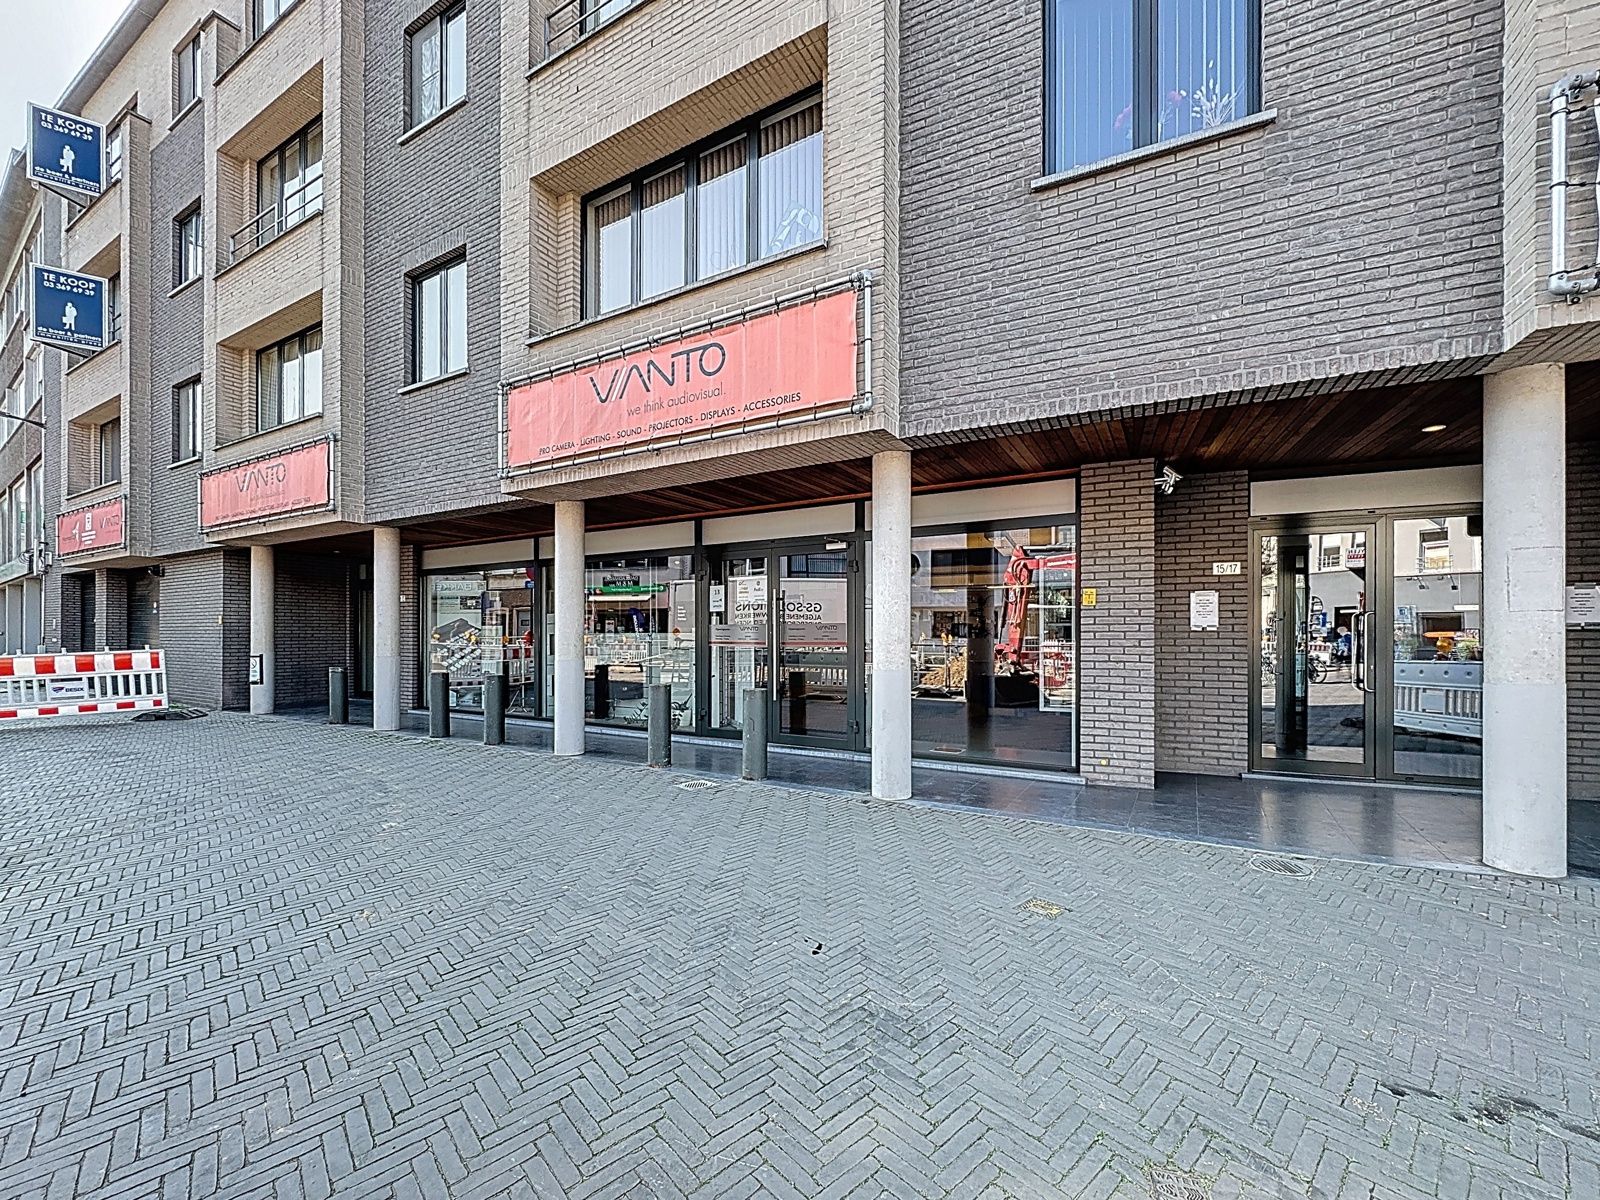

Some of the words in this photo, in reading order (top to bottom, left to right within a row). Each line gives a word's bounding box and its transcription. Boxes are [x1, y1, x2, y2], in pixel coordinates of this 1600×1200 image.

[40, 112, 53, 123] TE
[57, 118, 94, 134] KOOP
[41, 121, 52, 129] 03
[54, 125, 68, 133] 369
[71, 176, 99, 187] partners
[42, 272, 56, 282] TE
[59, 276, 96, 289] KOOP
[56, 283, 71, 291] 369
[73, 332, 102, 341] partners
[627, 406, 641, 417] we
[644, 397, 665, 414] think
[539, 446, 551, 456] PRO
[552, 440, 576, 454] CAMERA
[580, 433, 611, 446] LIGHTING
[616, 426, 642, 439] SOUND
[648, 416, 693, 434] PROJECTORS
[700, 406, 736, 422] DISPLAYS
[743, 392, 802, 415] ACCESSORIES
[1216, 564, 1238, 574] 15/17
